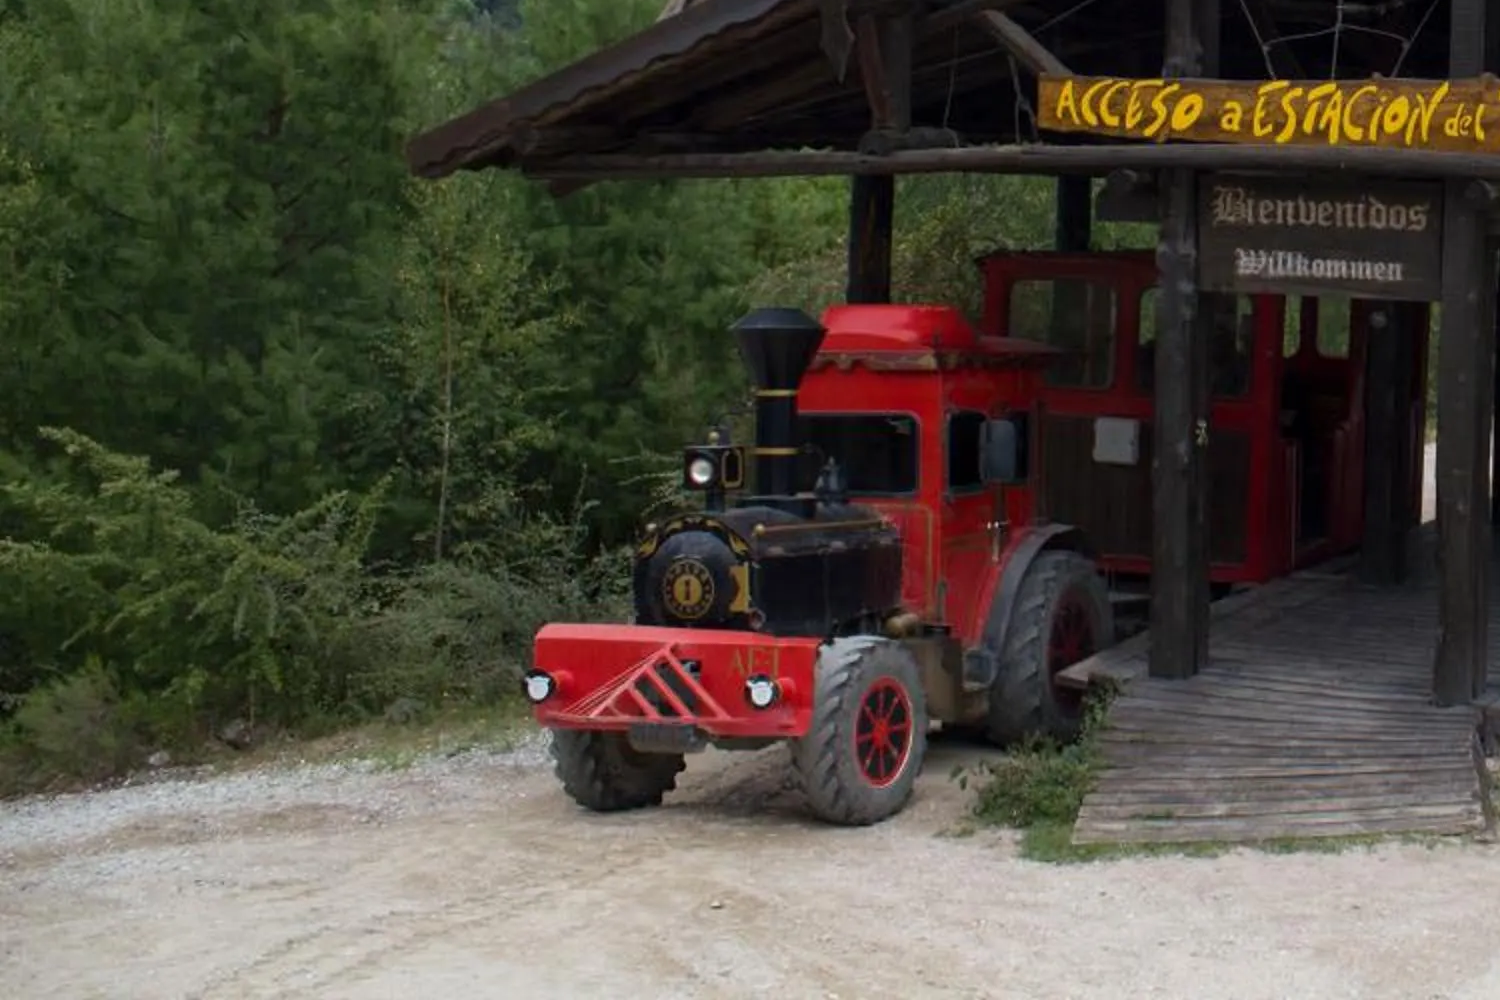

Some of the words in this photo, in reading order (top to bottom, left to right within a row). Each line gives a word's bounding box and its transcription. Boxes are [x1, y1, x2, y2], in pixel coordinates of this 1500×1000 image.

[1056, 79, 1203, 137] ACCESO
[1220, 101, 1241, 133] a
[1444, 103, 1485, 141] del
[1211, 186, 1430, 231] Bienvenidos
[1234, 248, 1404, 281] Willkommen
